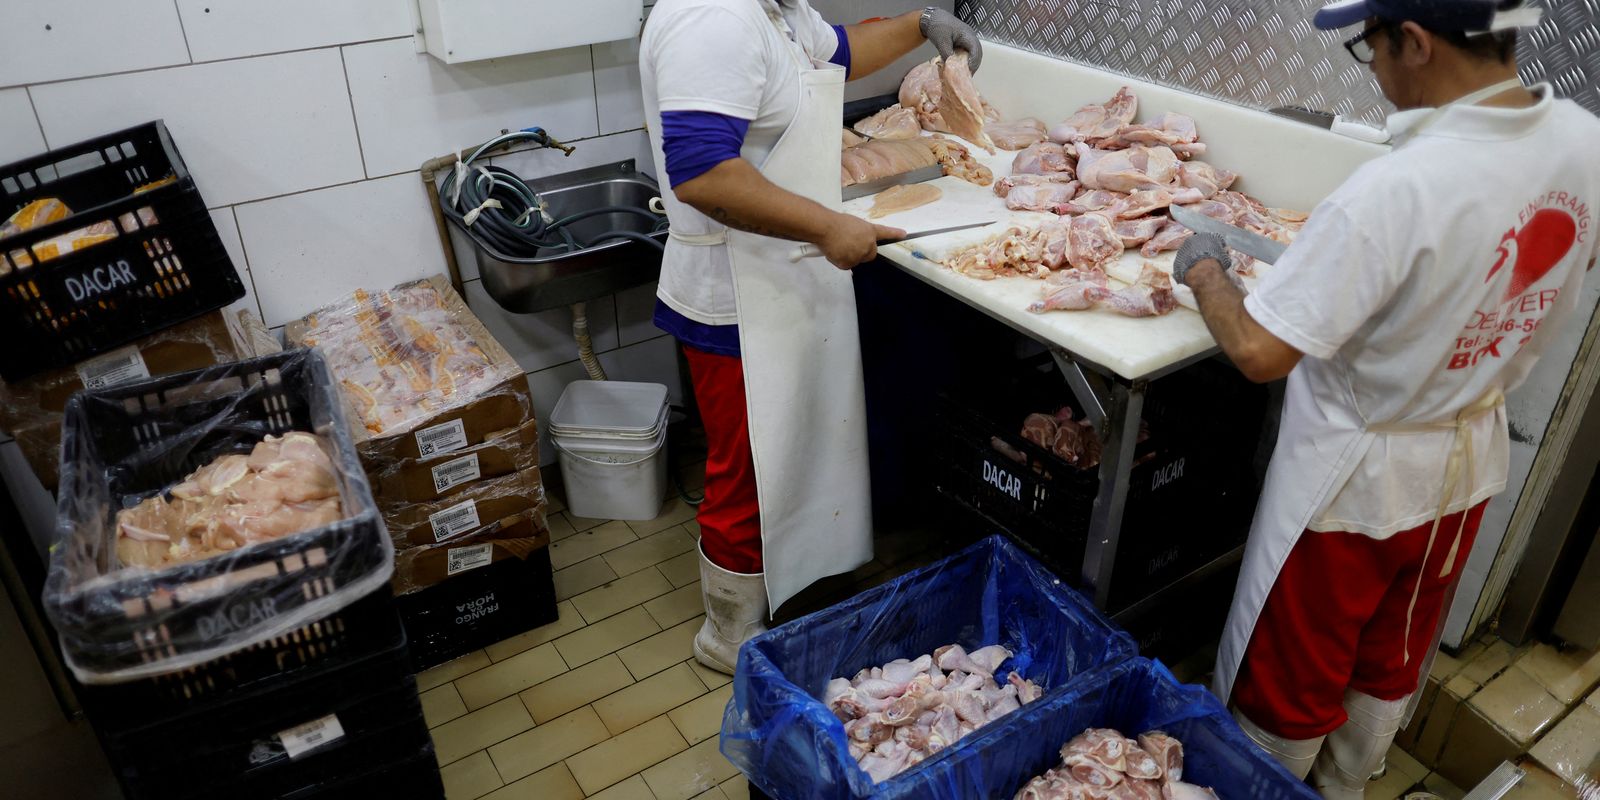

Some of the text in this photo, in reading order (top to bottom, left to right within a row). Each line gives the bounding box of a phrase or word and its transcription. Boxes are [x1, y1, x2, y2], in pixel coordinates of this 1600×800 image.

[65, 259, 137, 301] DACAR
[982, 459, 1022, 500] DACAR
[1151, 456, 1185, 491] DACAR
[195, 596, 279, 640] DACAR
[455, 592, 495, 613] HORA
[455, 602, 500, 625] FRANGO
